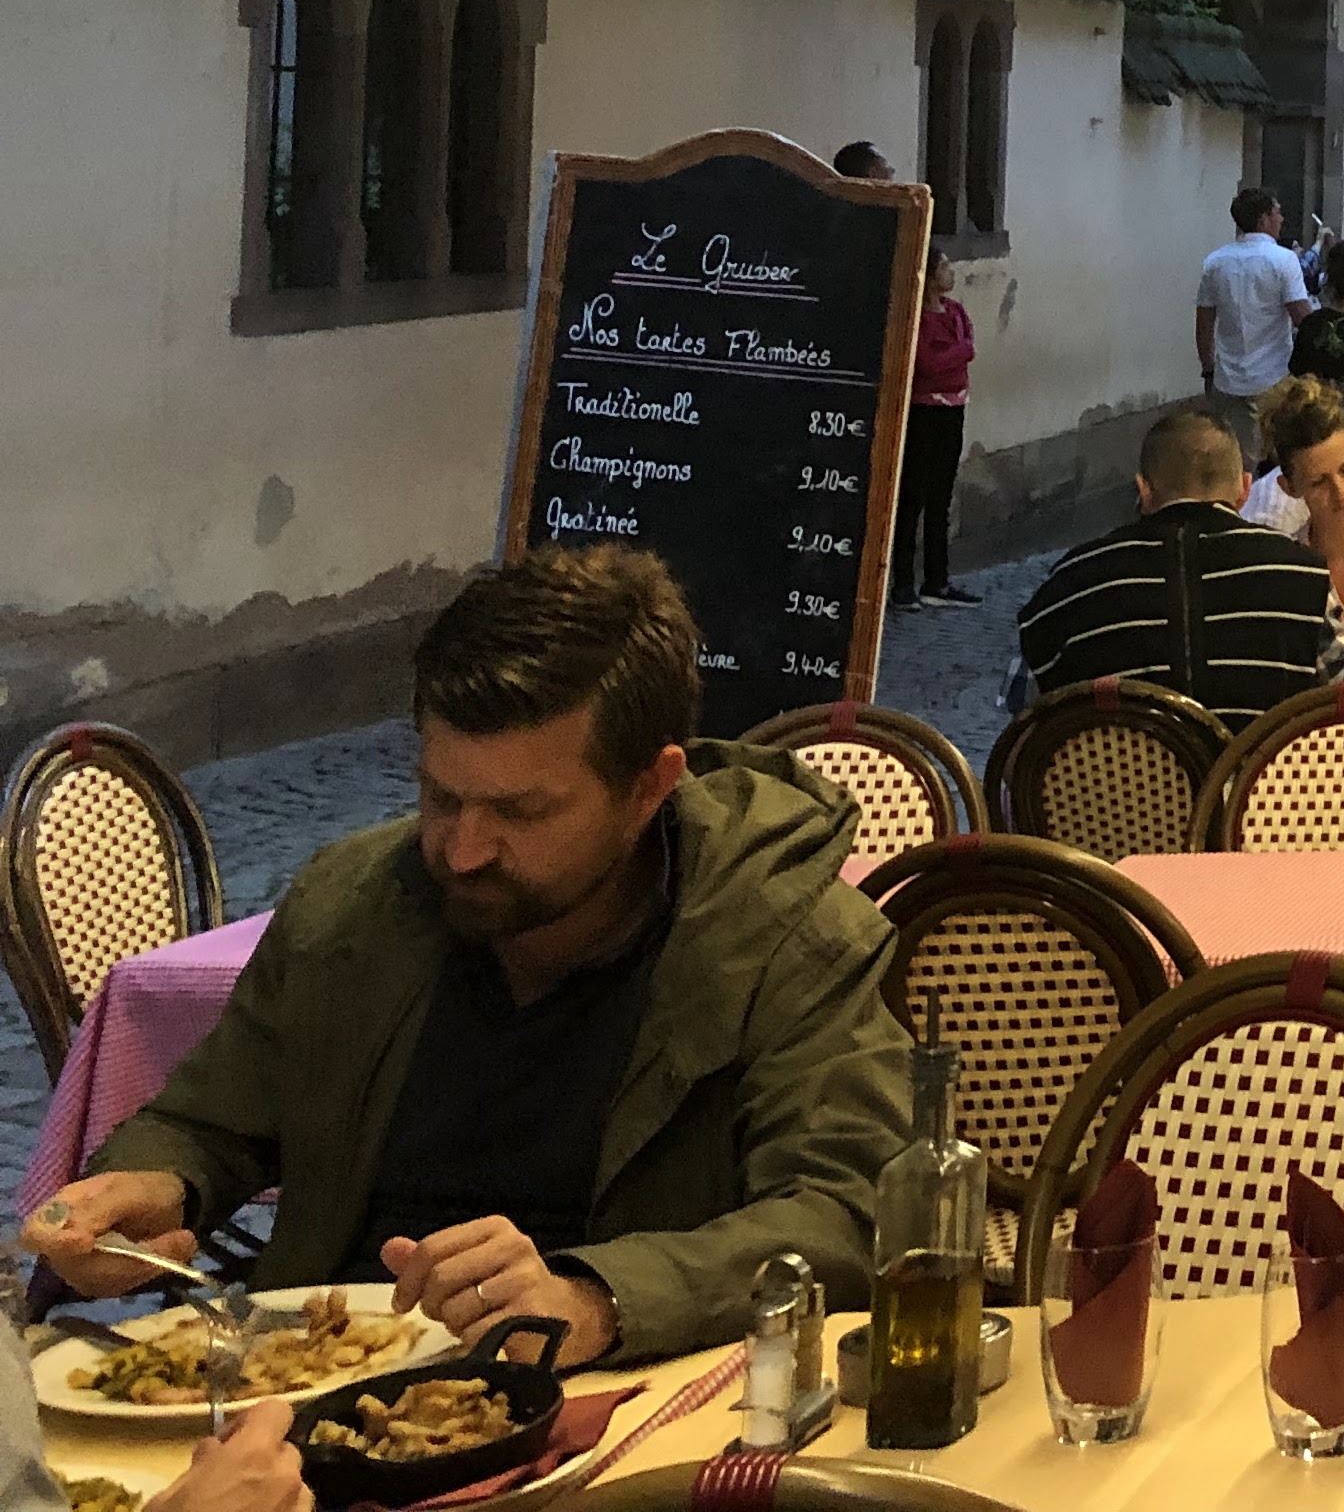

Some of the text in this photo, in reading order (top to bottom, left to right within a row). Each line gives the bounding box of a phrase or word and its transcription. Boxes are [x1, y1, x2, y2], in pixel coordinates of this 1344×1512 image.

[631, 222, 800, 294] Le Gruber
[568, 292, 832, 367] Nos tartes Flambées
[556, 382, 700, 425] Traditionelle
[550, 435, 692, 489] Champignons
